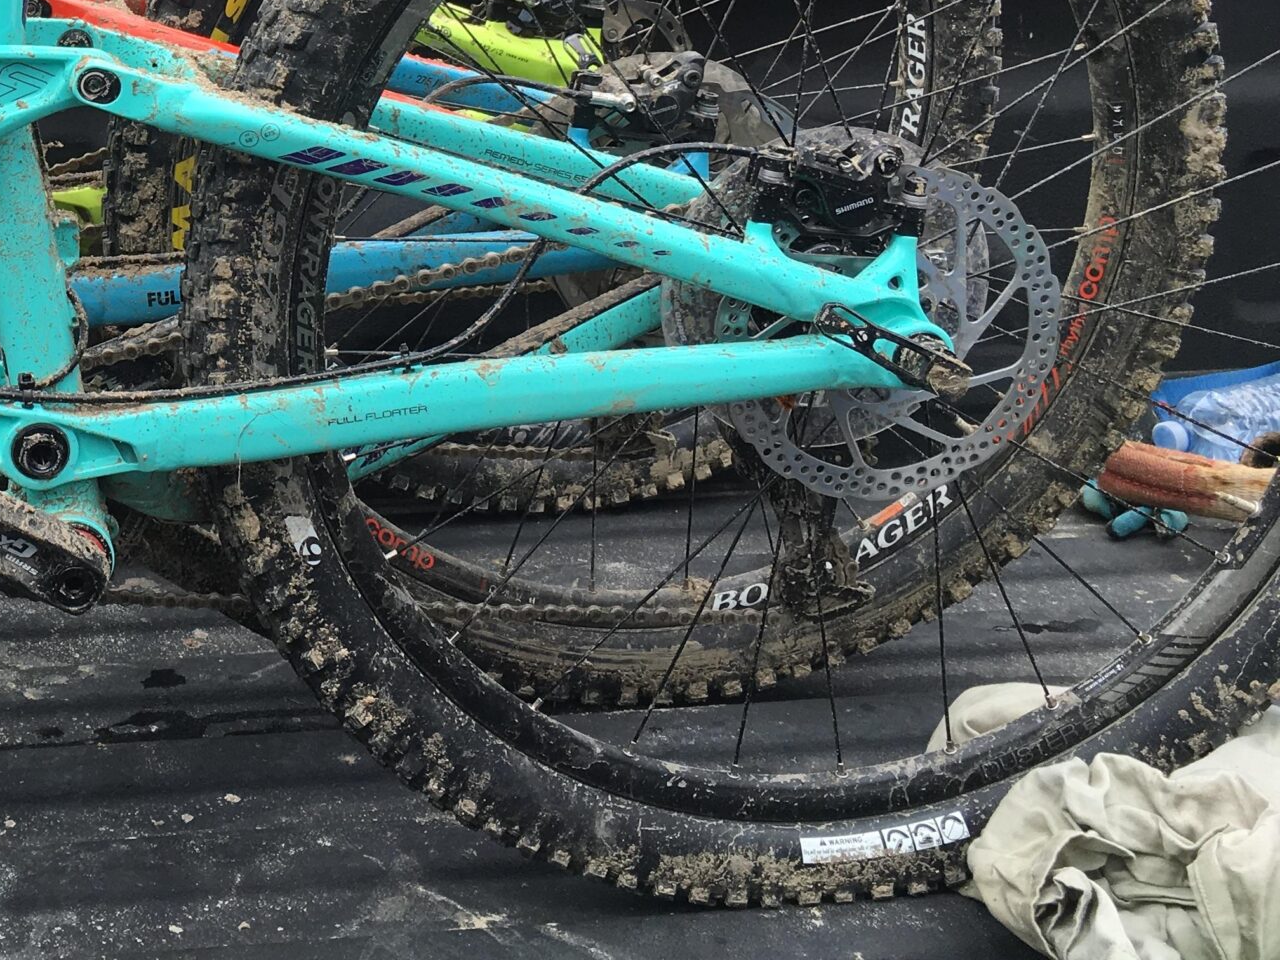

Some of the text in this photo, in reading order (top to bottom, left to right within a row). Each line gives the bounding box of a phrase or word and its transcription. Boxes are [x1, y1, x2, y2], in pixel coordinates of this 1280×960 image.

[484, 148, 533, 168] REMEDY
[534, 163, 572, 180] SERIES
[834, 196, 875, 216] SHIMANO
[296, 175, 336, 375] ONTRAGER
[327, 404, 428, 427] FULL FLOATER
[4, 553, 39, 576] SRAM
[979, 721, 1080, 783] DUSTER
[828, 836, 863, 846] WARNING
